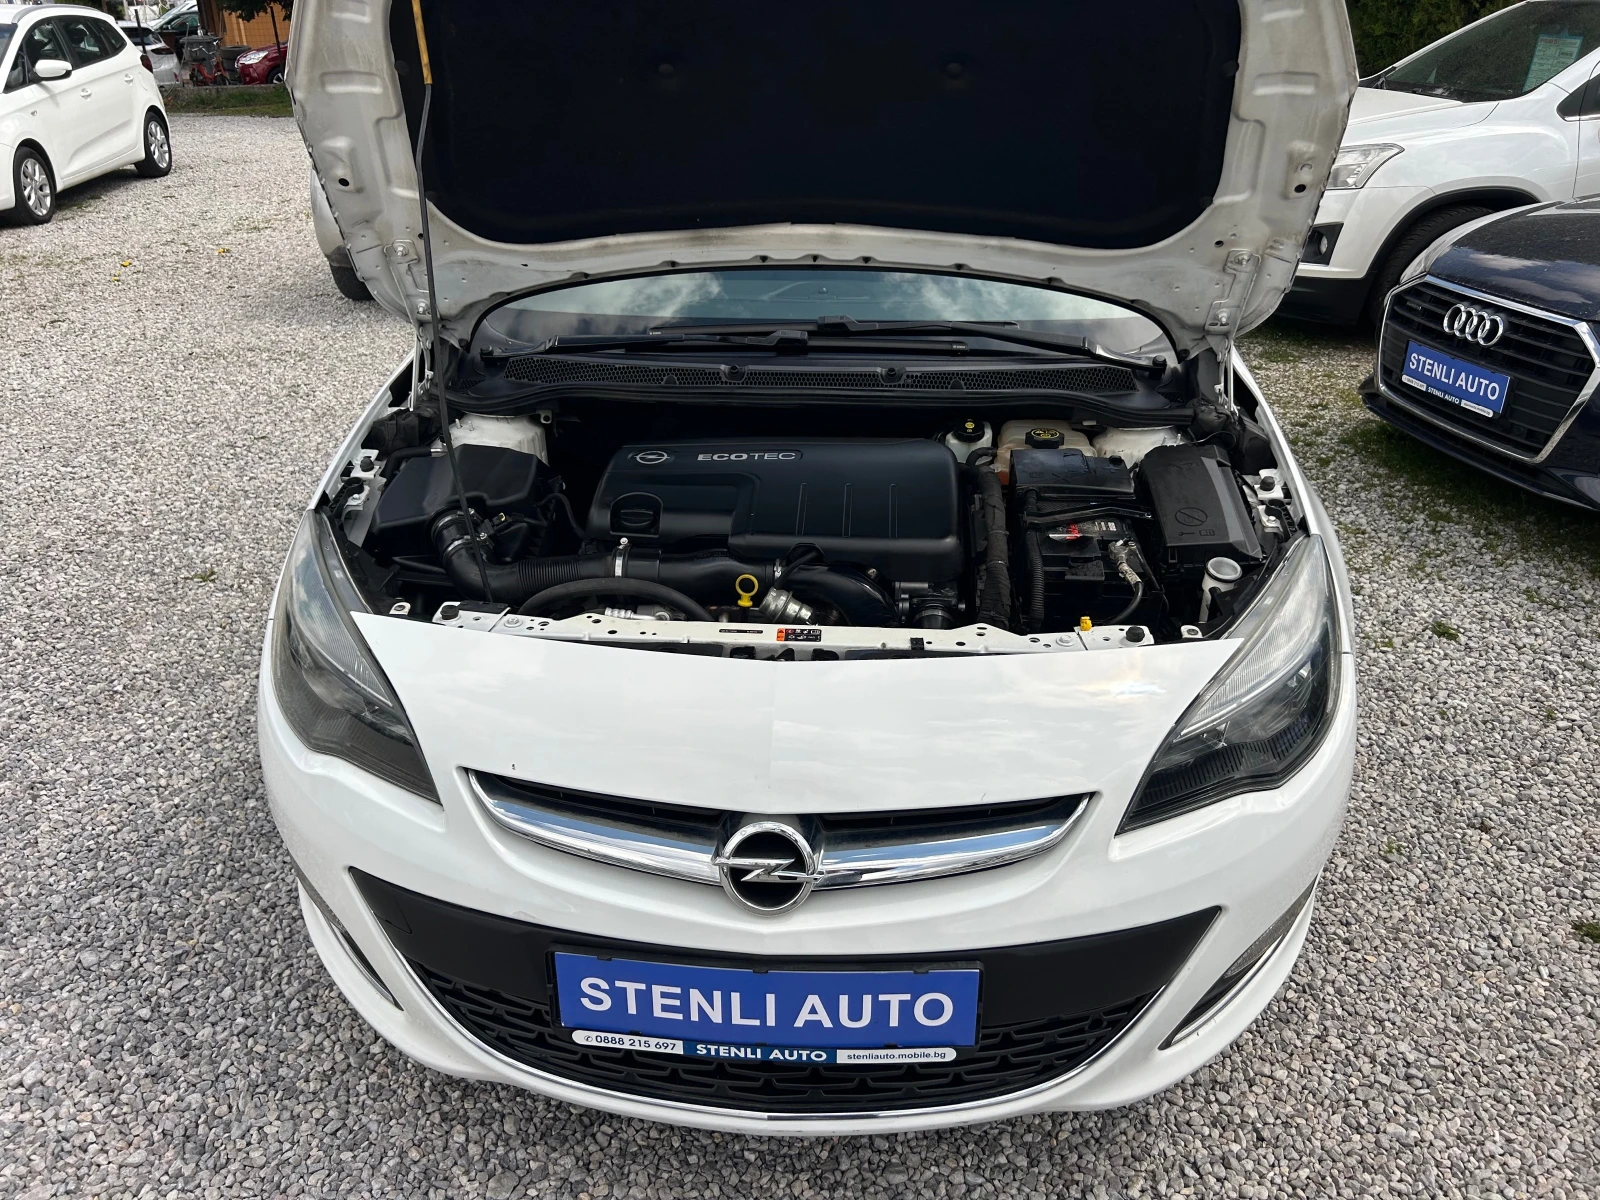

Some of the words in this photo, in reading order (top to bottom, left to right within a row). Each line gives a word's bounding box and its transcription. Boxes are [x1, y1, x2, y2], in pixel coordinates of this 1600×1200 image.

[1409, 353, 1455, 385] STENLI
[1455, 372, 1500, 401] AUTO
[1427, 386, 1444, 398] STENLI
[1444, 393, 1460, 405] AUTO
[697, 452, 796, 461] ECOTEC
[580, 976, 776, 1027] STENLI
[793, 992, 954, 1028] AUTO
[595, 1035, 625, 1046] 0888
[628, 1038, 651, 1048] 215
[654, 1041, 677, 1051] 697
[696, 1044, 762, 1059] STENLI
[769, 1049, 827, 1061] AUTO
[847, 1051, 946, 1061] stenliauto.mobile.bg
